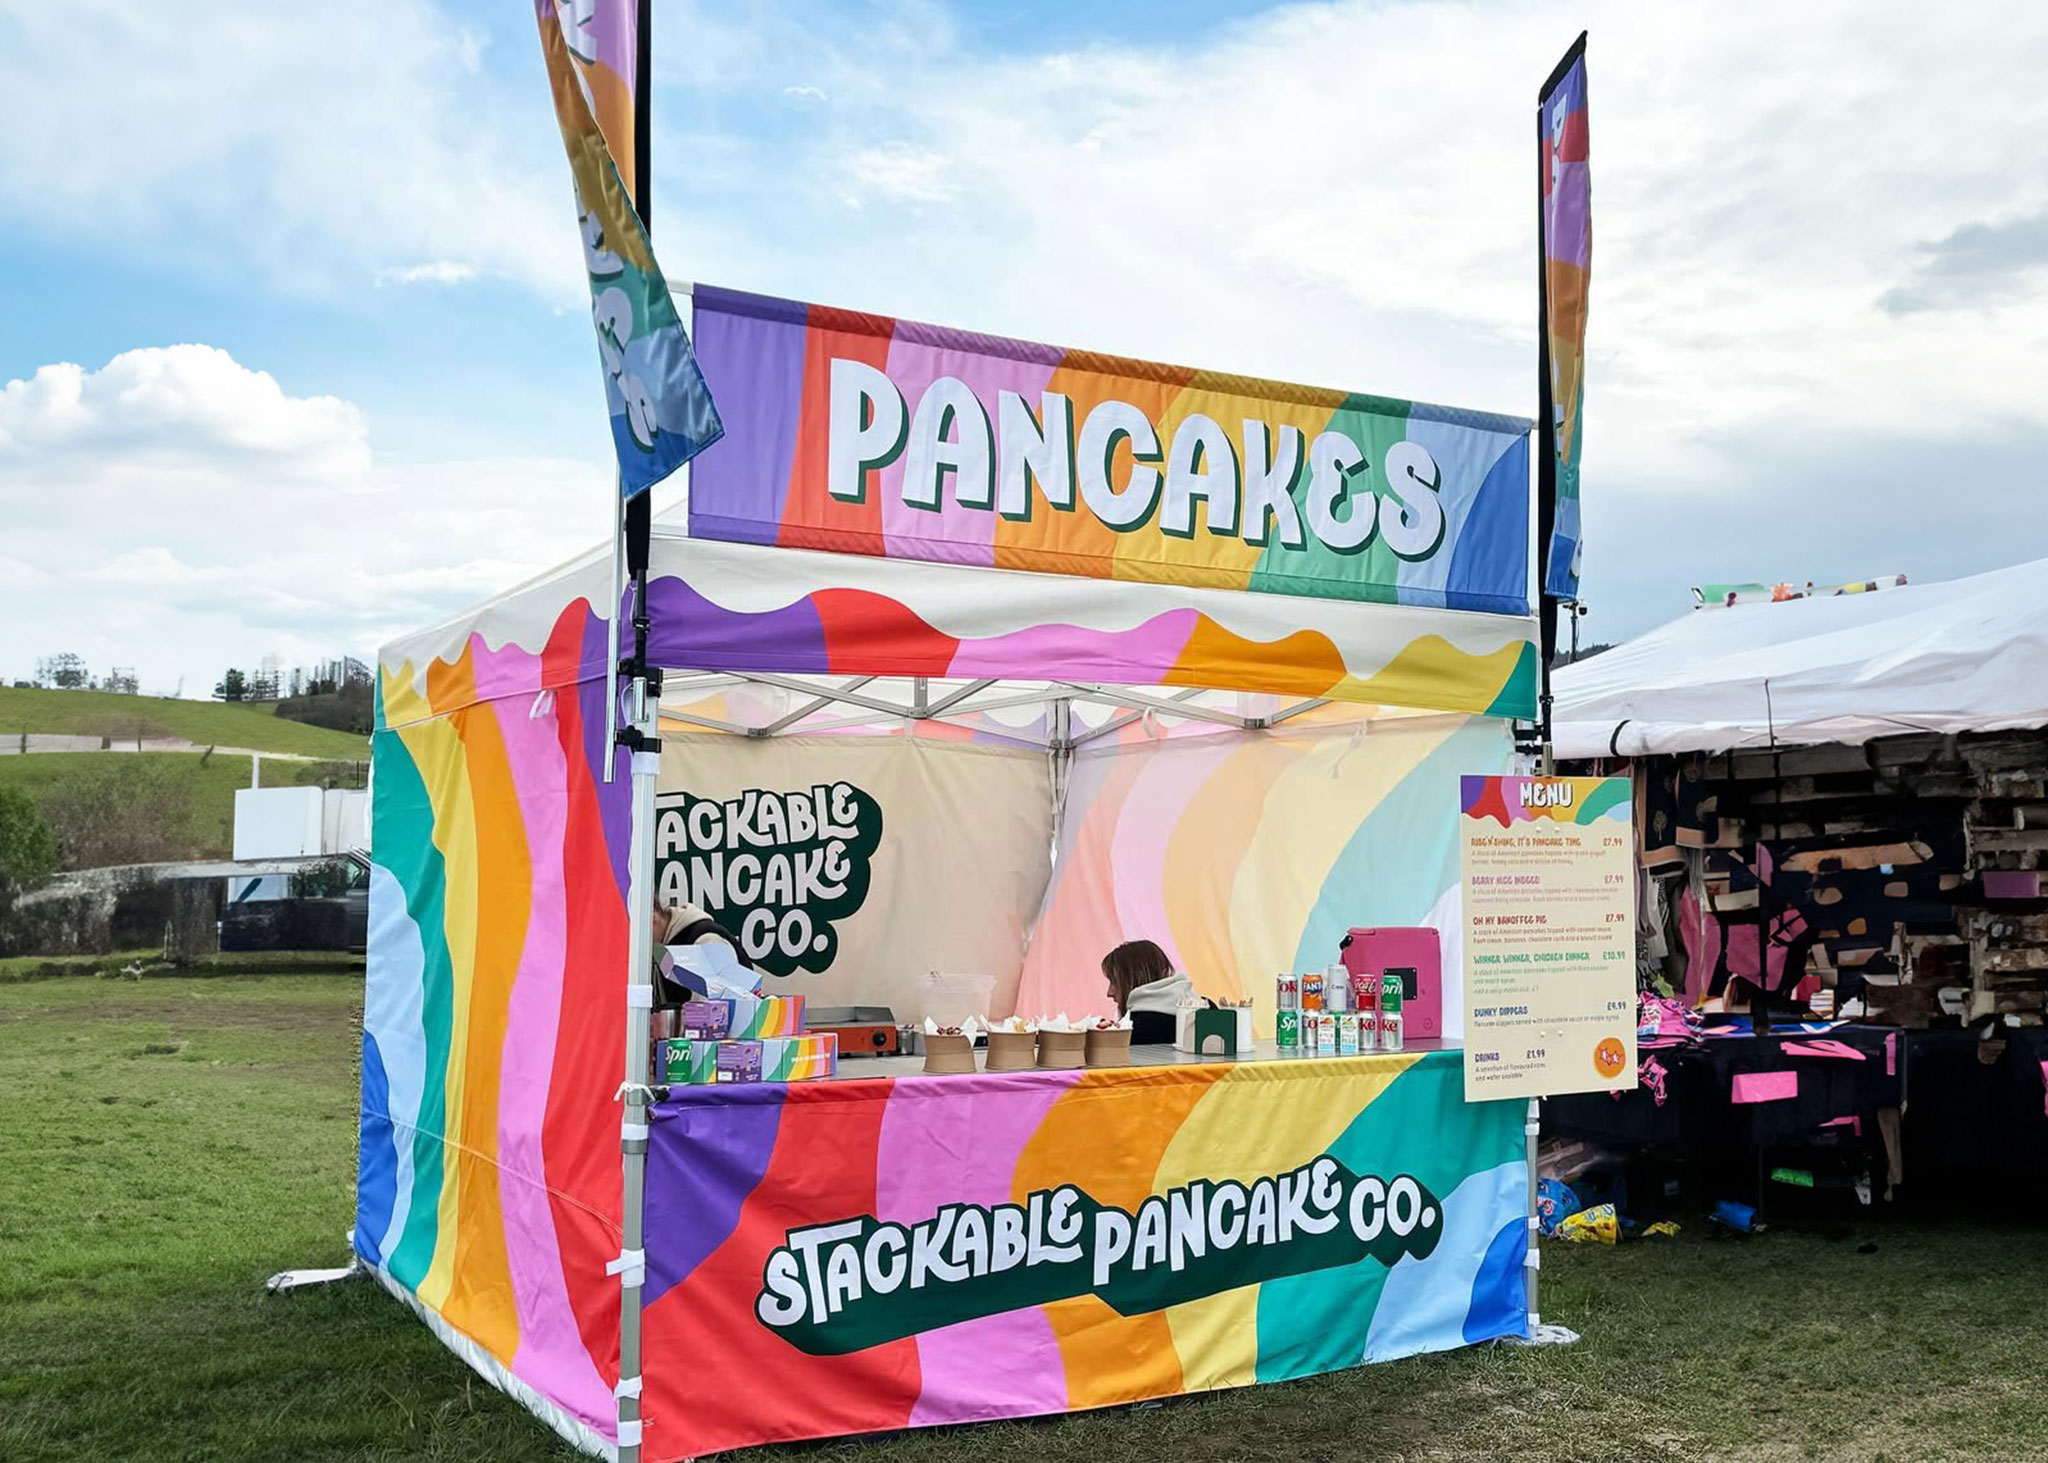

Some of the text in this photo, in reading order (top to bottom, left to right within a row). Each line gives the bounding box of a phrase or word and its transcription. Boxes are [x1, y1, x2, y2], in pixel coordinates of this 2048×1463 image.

[828, 358, 1446, 562] PANCAKES
[1520, 782, 1573, 807] MENU
[656, 784, 860, 859] ACKABLE
[1603, 837, 1623, 847] £7.99
[659, 840, 851, 910] ANCAKE
[1604, 874, 1625, 884] £7.99
[1473, 916, 1484, 926] OH
[1485, 916, 1496, 925] MY
[1605, 913, 1625, 923] £7.99
[741, 908, 829, 960] CO.
[1474, 1006, 1498, 1018] DUNKY
[1499, 1005, 1529, 1016] DIPPERS
[665, 1045, 693, 1065] Spri
[1474, 1048, 1546, 1063] DRINKS £1.99
[758, 1160, 1437, 1326] STACKABLE PANCAKE CO.
